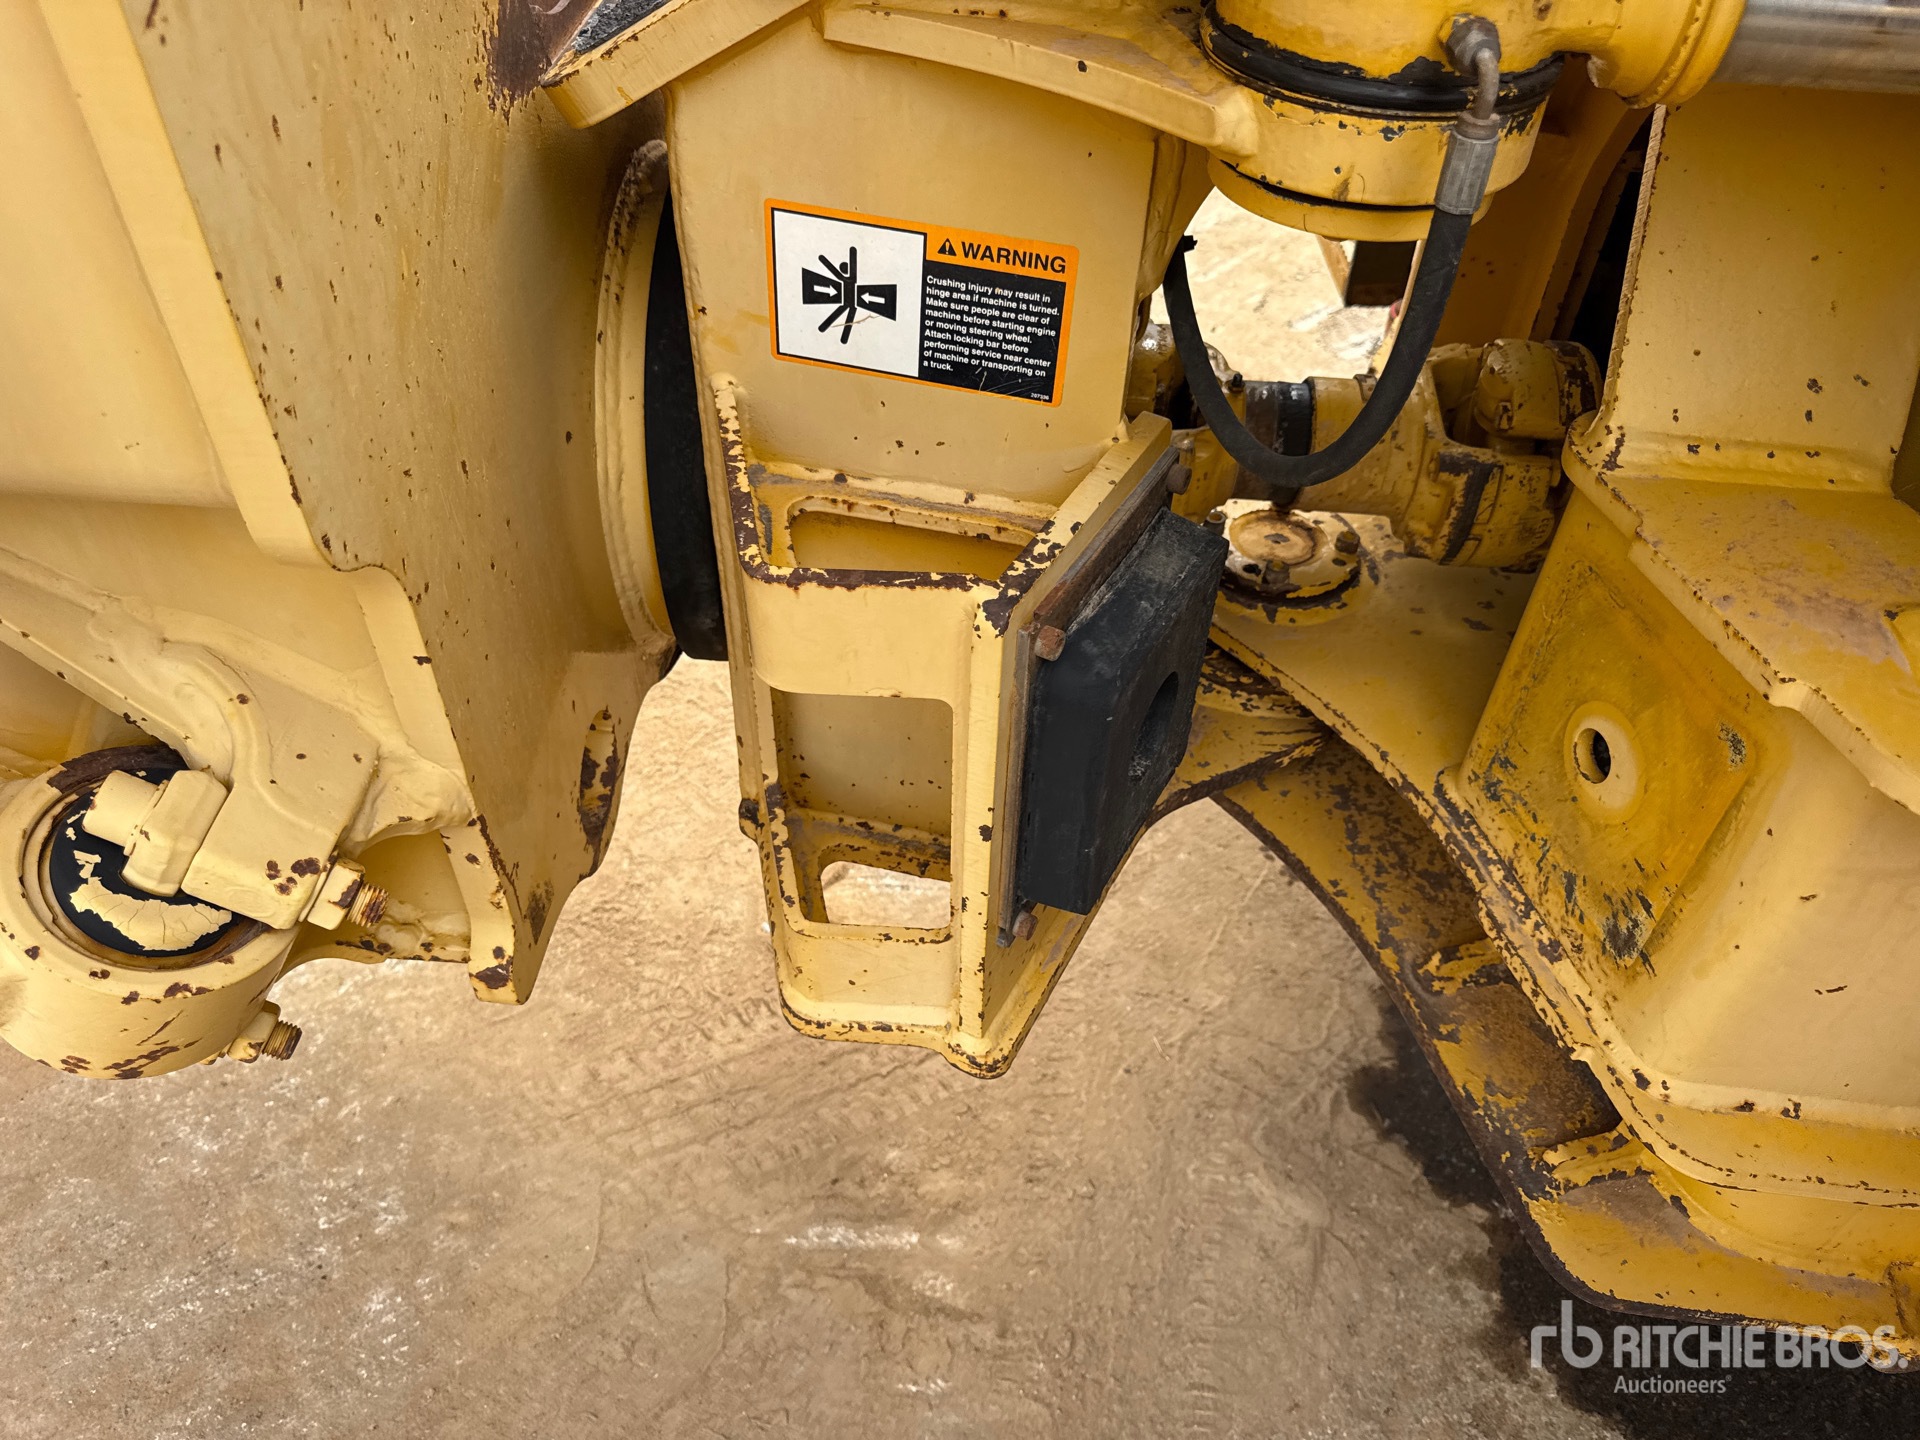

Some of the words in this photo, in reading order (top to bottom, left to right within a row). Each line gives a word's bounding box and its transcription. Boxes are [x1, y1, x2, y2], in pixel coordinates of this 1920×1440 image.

[962, 242, 1066, 274] WARNING
[926, 286, 950, 298] hinge
[952, 292, 970, 300] area
[973, 294, 978, 302] if
[981, 296, 1017, 308] machine
[1020, 302, 1027, 310] is
[1029, 303, 1059, 316] turned.
[927, 276, 966, 290] Crushing
[968, 281, 993, 294] injury
[995, 287, 1013, 298] may
[1015, 290, 1040, 301] result
[1042, 294, 1050, 303] in
[926, 297, 948, 308] Make
[950, 302, 969, 311] sure
[972, 305, 1000, 317] people
[1002, 310, 1016, 319] are
[1018, 312, 1039, 322] clear
[1041, 316, 1050, 324] of
[926, 309, 961, 320] machine
[963, 316, 990, 326] before
[992, 320, 1024, 332] starting
[1027, 326, 1056, 336] engine
[925, 328, 951, 340] Attach
[954, 334, 984, 347] locking
[986, 339, 1000, 348] bar
[1002, 342, 1028, 353] before
[936, 322, 966, 334] moving
[969, 327, 1003, 340] steering
[1006, 332, 1032, 343] wheel.
[924, 340, 969, 355] performing
[972, 349, 1002, 358] service
[1004, 354, 1022, 362] near
[1024, 357, 1051, 367] center
[930, 360, 953, 370] truck.
[934, 352, 968, 364] machine
[982, 360, 1033, 376] transporting
